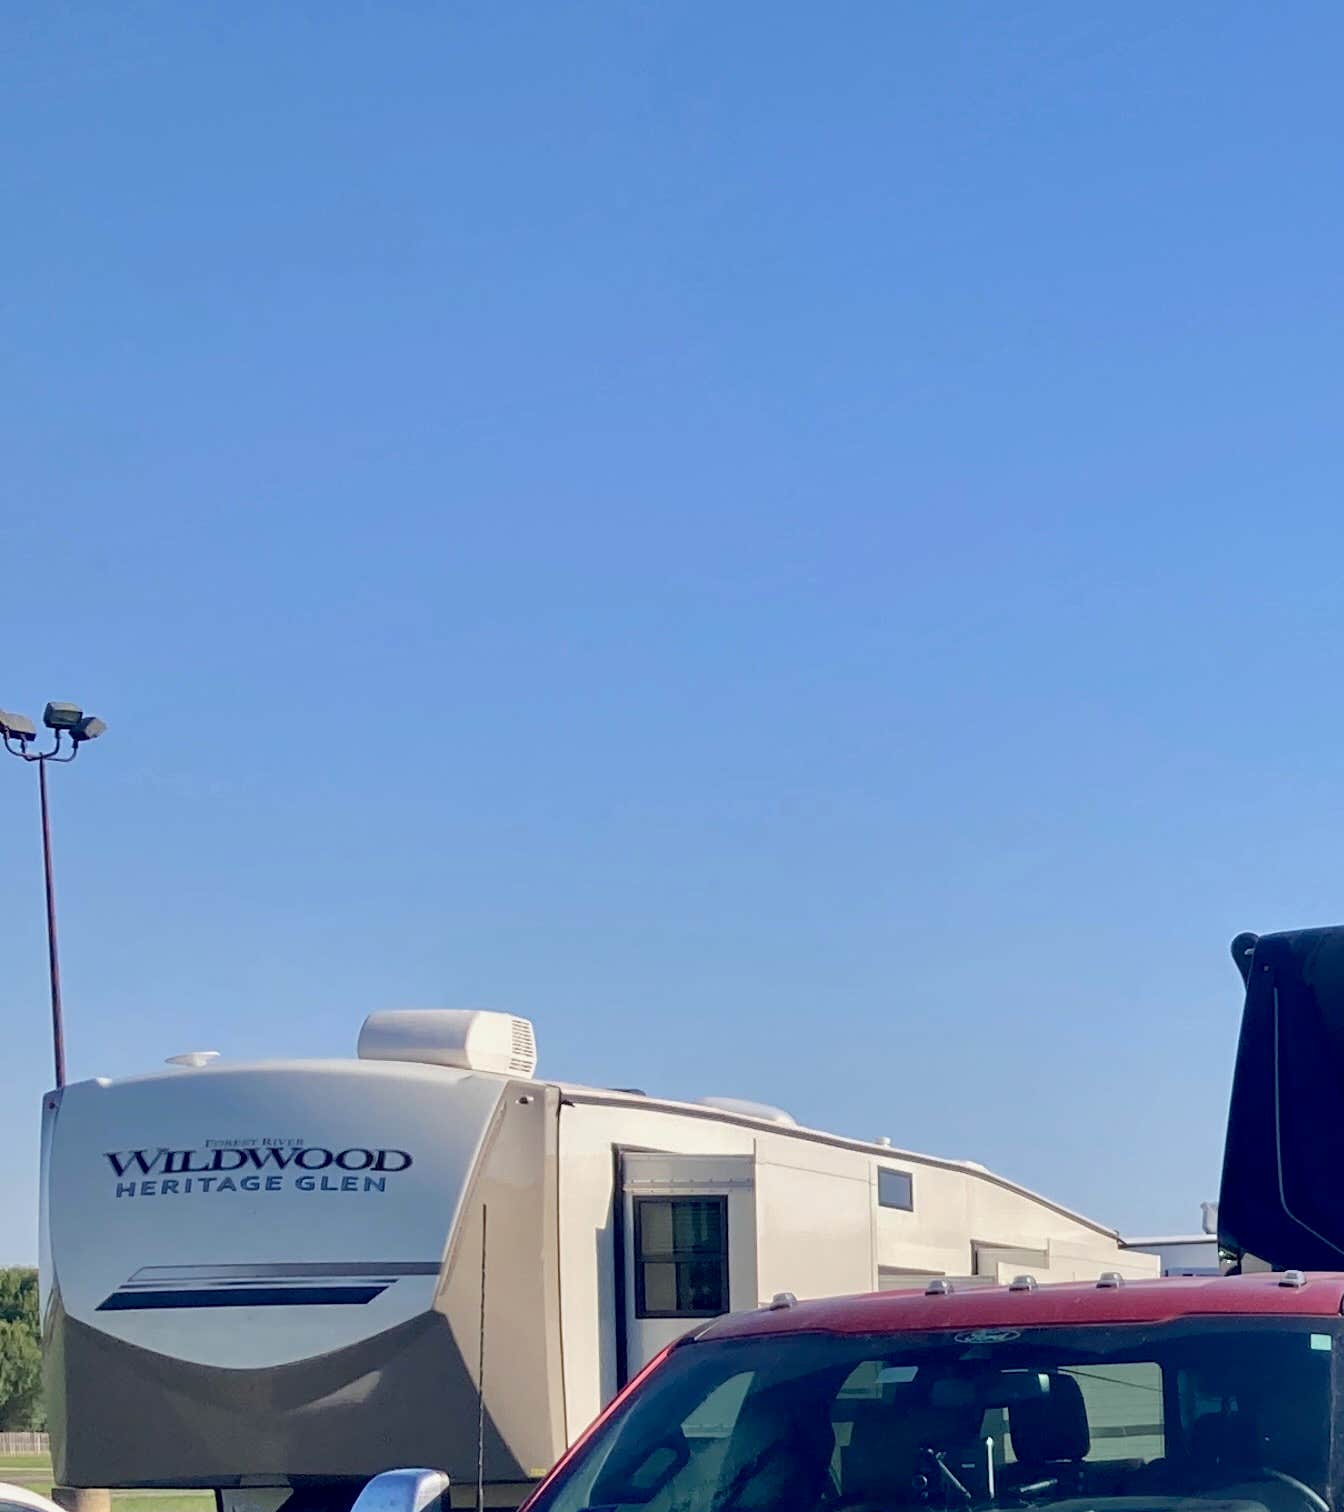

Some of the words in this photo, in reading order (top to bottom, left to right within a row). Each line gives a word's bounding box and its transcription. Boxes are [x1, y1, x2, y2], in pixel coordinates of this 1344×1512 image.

[261, 1137, 305, 1148] RIVER
[103, 1146, 414, 1178] WILDWOOD
[115, 1175, 284, 1199] HERITAGE
[294, 1175, 387, 1193] GLEN
